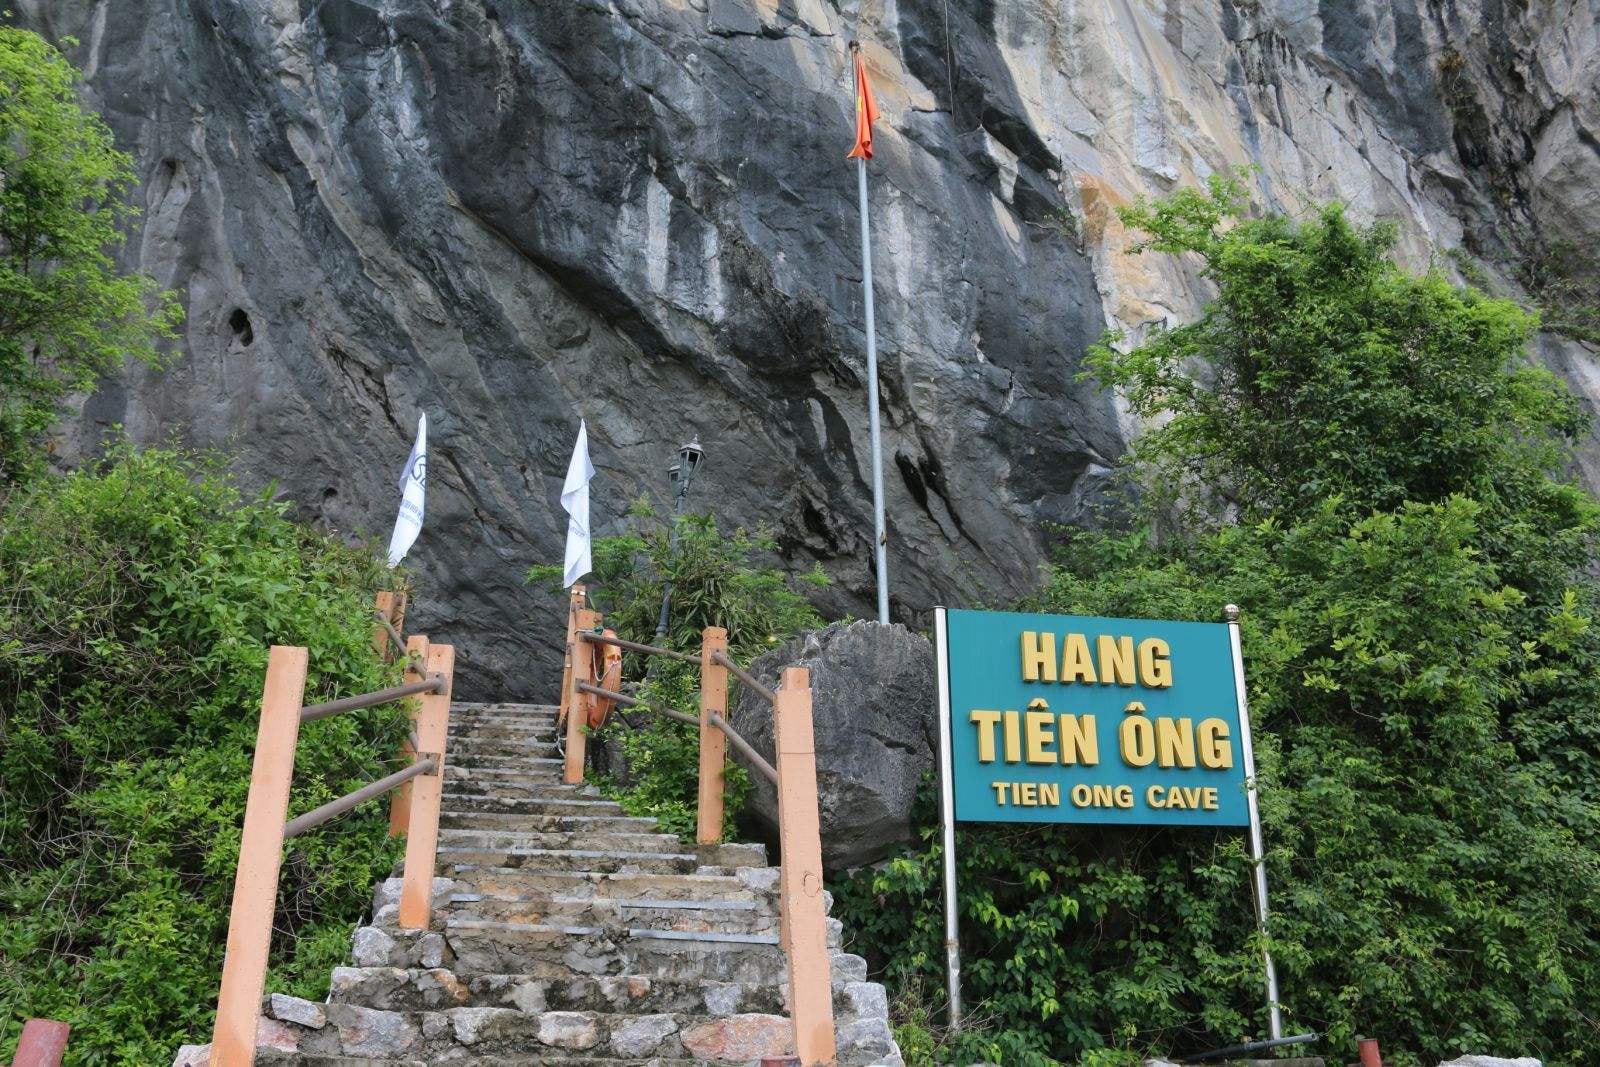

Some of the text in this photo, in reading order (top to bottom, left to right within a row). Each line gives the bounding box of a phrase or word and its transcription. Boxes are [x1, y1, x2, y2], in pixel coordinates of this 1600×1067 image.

[1021, 631, 1173, 688] HANG
[970, 697, 1233, 770] TIÊN ÔNG
[992, 781, 1219, 810] TIEN ONG CAVE
